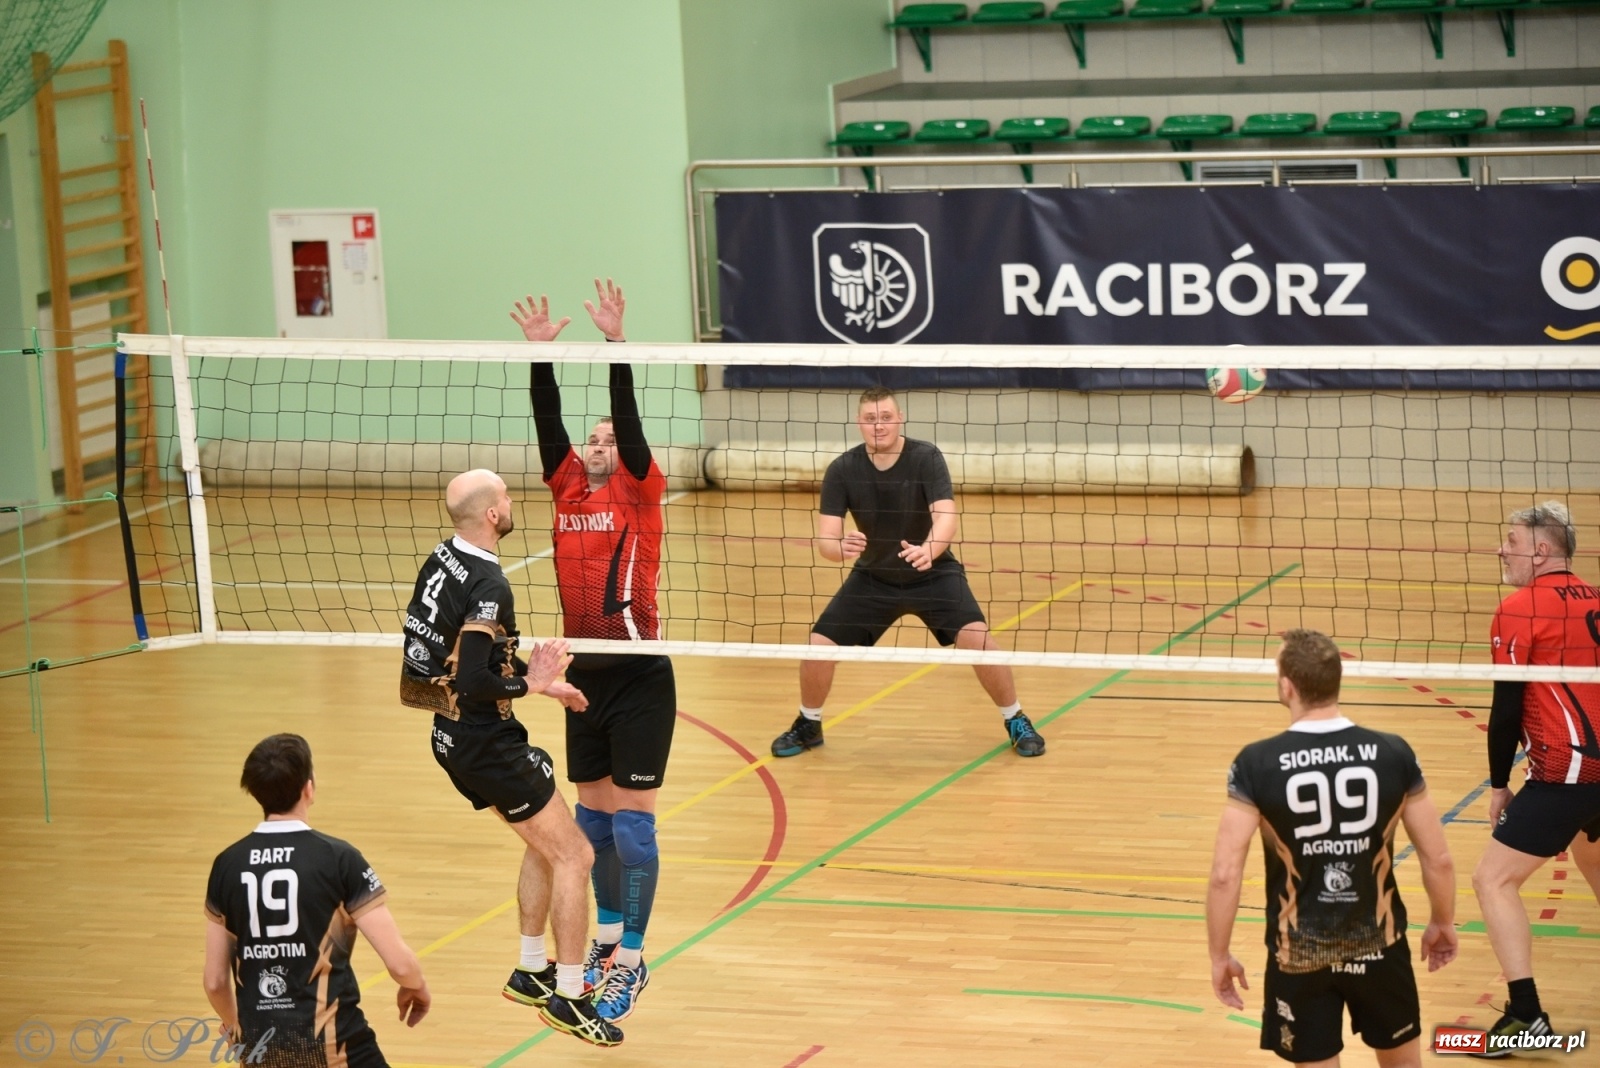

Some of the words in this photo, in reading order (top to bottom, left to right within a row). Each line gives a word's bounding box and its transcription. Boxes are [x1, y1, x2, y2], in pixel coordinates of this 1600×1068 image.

[1002, 243, 1368, 317] RACIBÓRZ
[421, 567, 447, 623] 4
[1279, 745, 1354, 771] SIORAK.
[1358, 744, 1378, 761] W
[1286, 766, 1379, 839] 99
[250, 847, 295, 864] BART
[1302, 836, 1370, 856] AGROTIM
[240, 868, 299, 938] 19
[243, 943, 307, 960] AGROTIM
